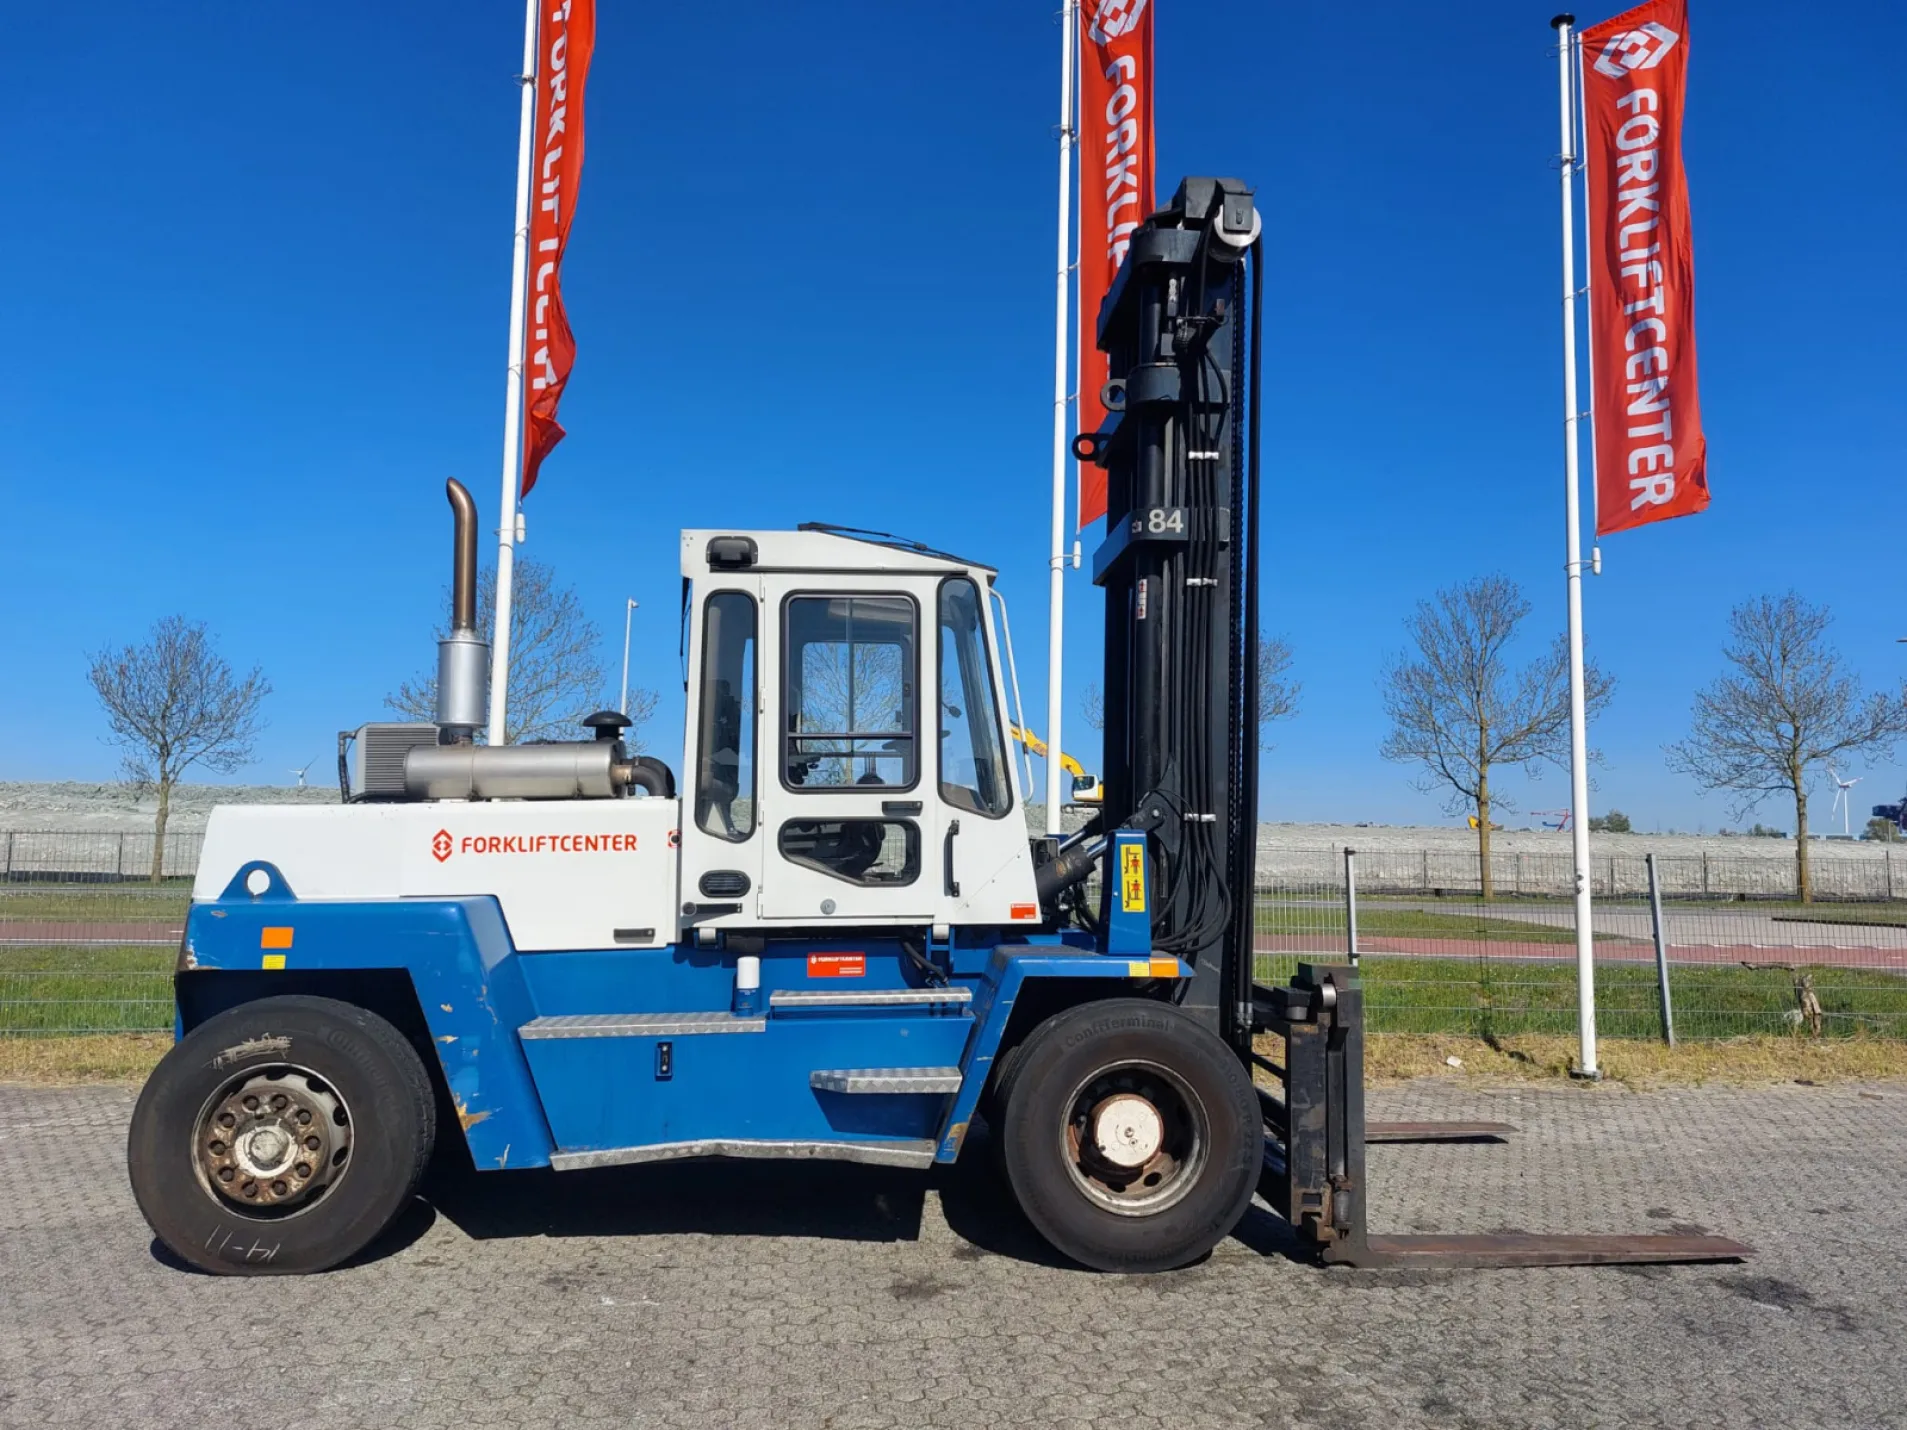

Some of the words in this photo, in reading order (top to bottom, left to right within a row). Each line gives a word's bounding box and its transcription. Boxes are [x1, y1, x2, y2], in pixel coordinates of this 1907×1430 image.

[1615, 87, 1676, 511] FORKLIFTCENTER
[1148, 509, 1184, 533] 84
[461, 834, 637, 853] FORKLIFTCENTER
